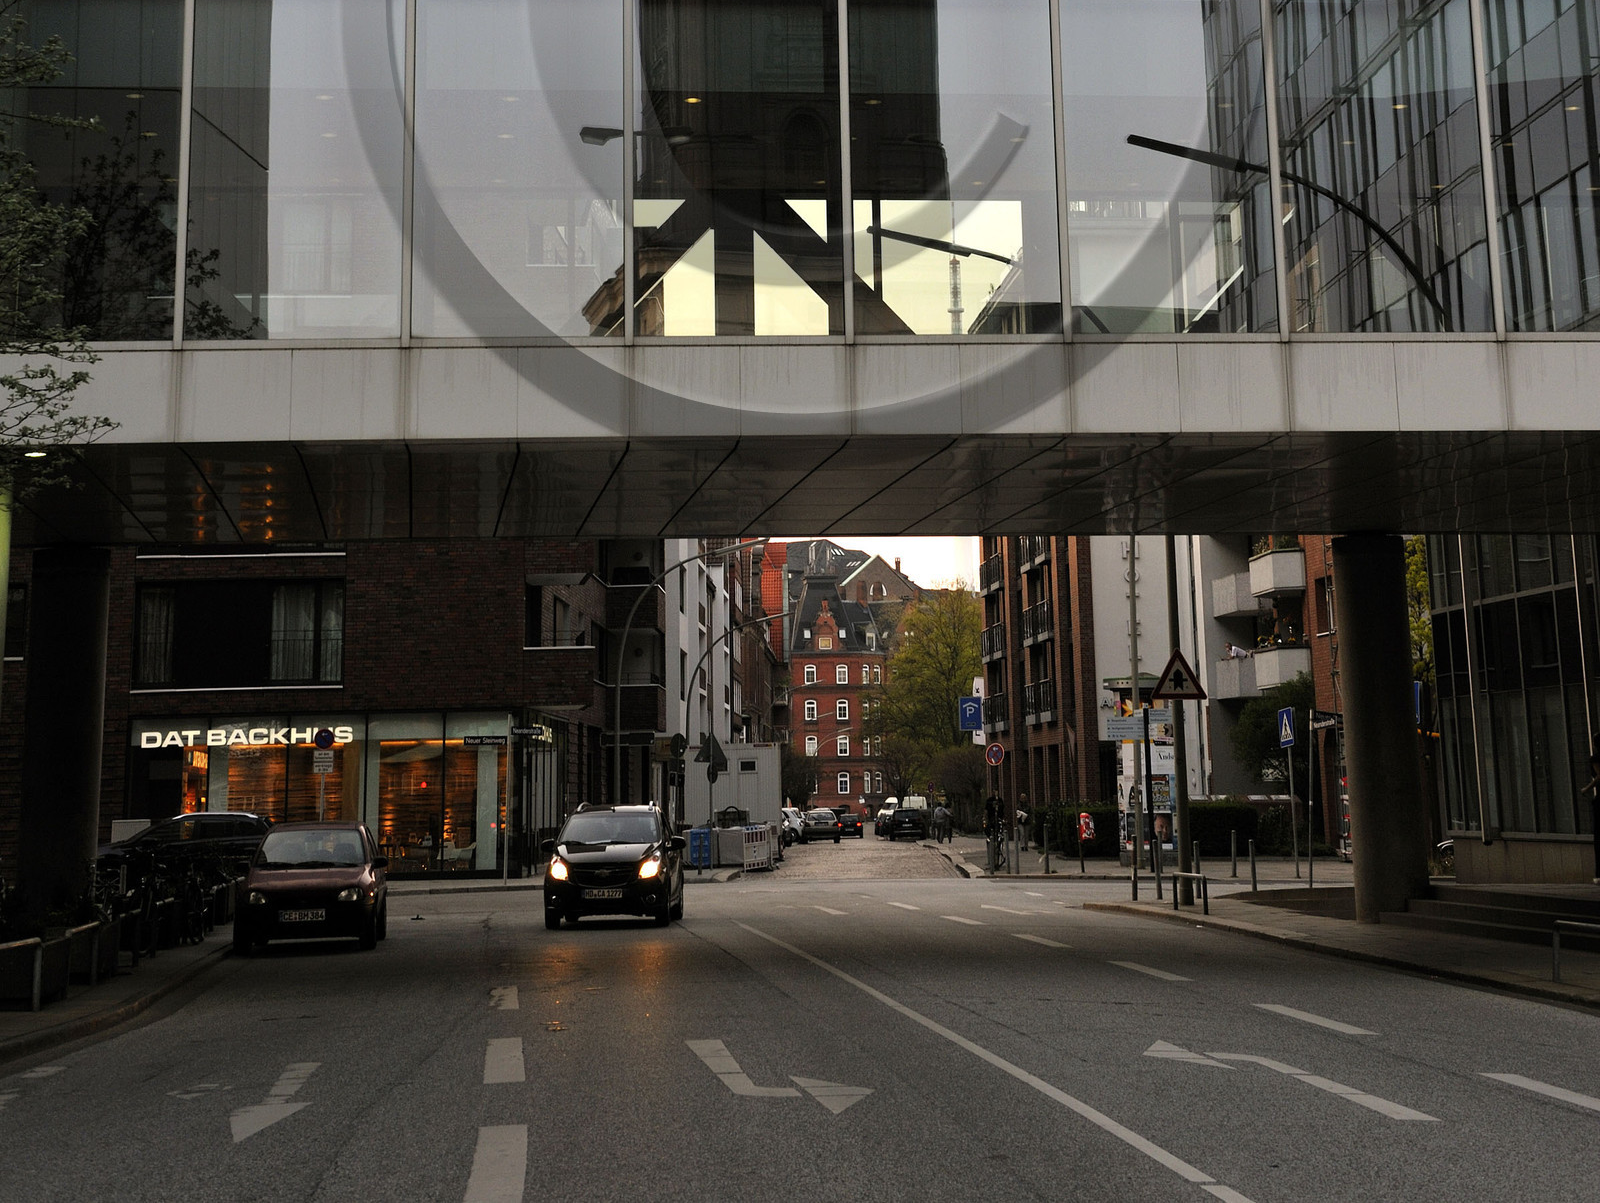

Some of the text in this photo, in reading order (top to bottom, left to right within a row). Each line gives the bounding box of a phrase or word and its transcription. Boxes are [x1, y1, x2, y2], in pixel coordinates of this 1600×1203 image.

[1121, 541, 1142, 661] HOEL
[967, 707, 975, 717] P
[140, 730, 201, 749] DAT
[482, 736, 506, 745] Steinweg
